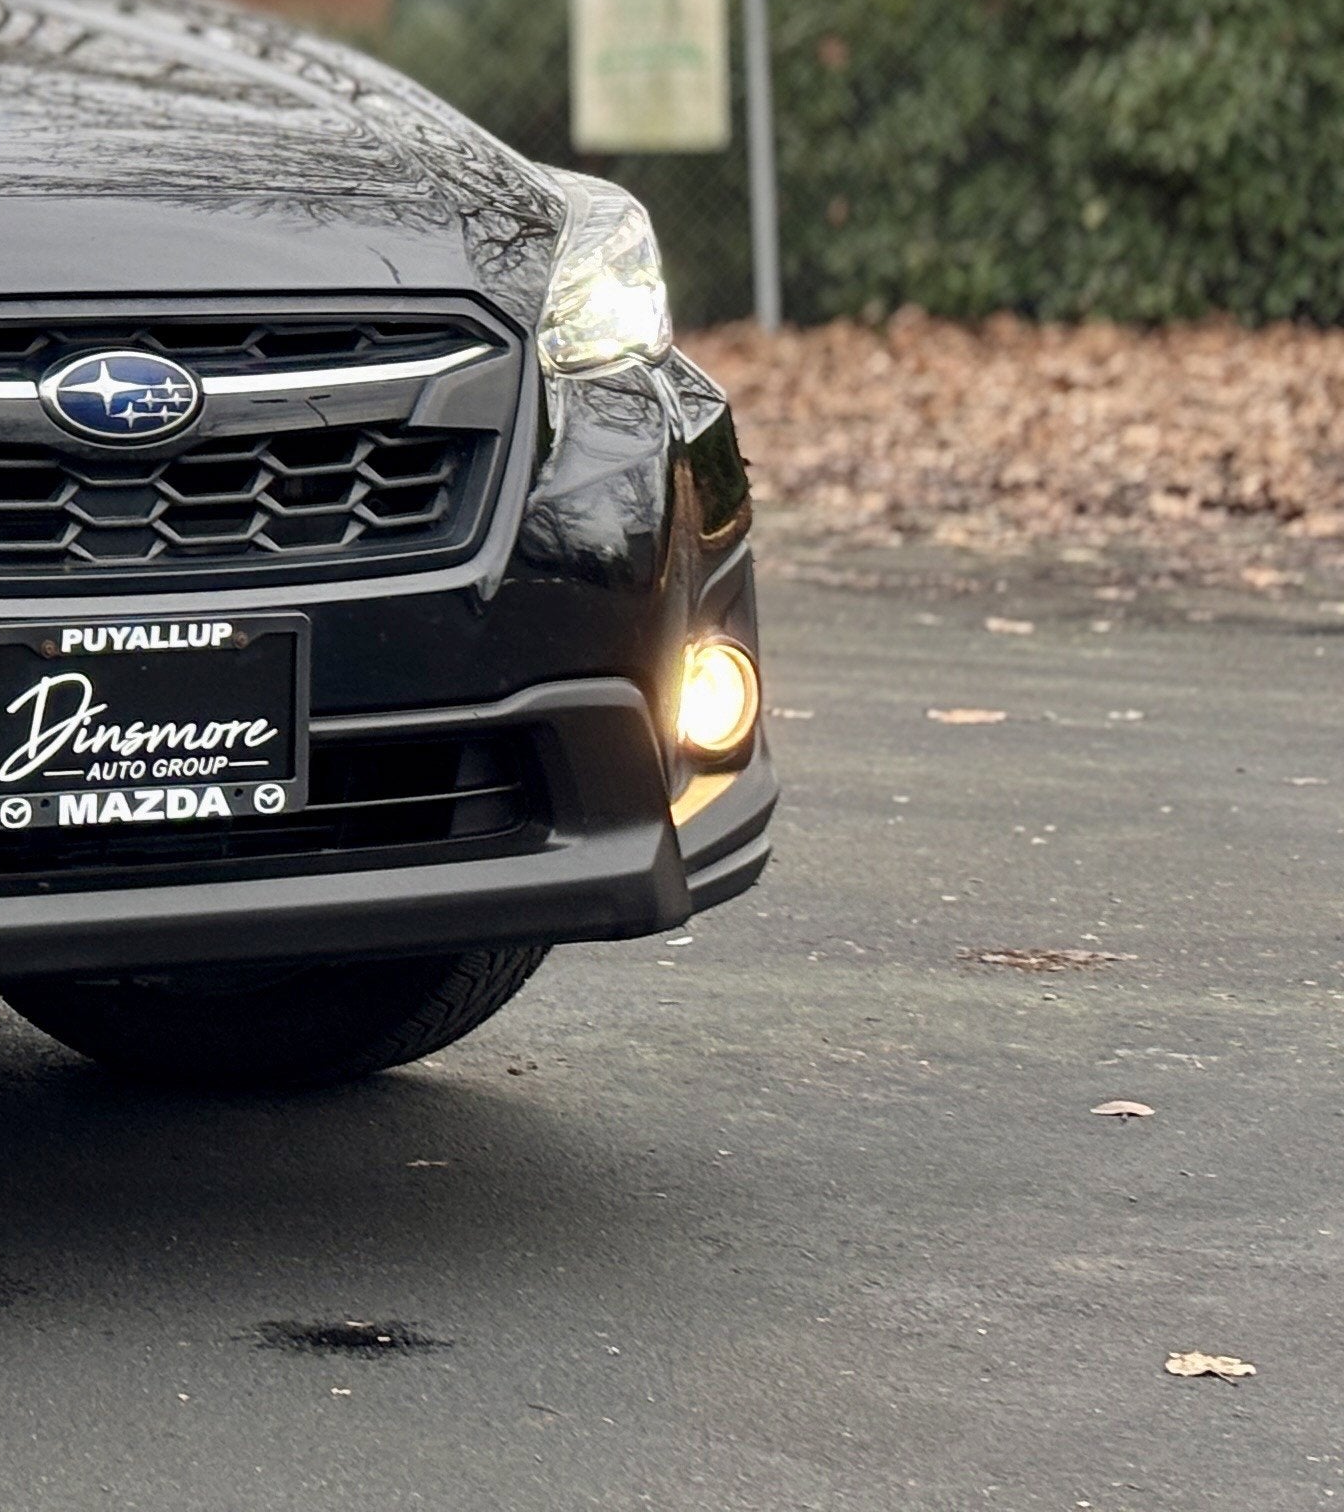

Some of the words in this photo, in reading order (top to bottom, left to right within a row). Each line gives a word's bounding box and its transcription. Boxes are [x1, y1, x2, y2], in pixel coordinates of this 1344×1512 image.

[61, 622, 233, 653] PUYALLUP
[86, 760, 146, 781] AUTO
[152, 756, 229, 777] GROUP
[59, 786, 232, 826] MAZDA
